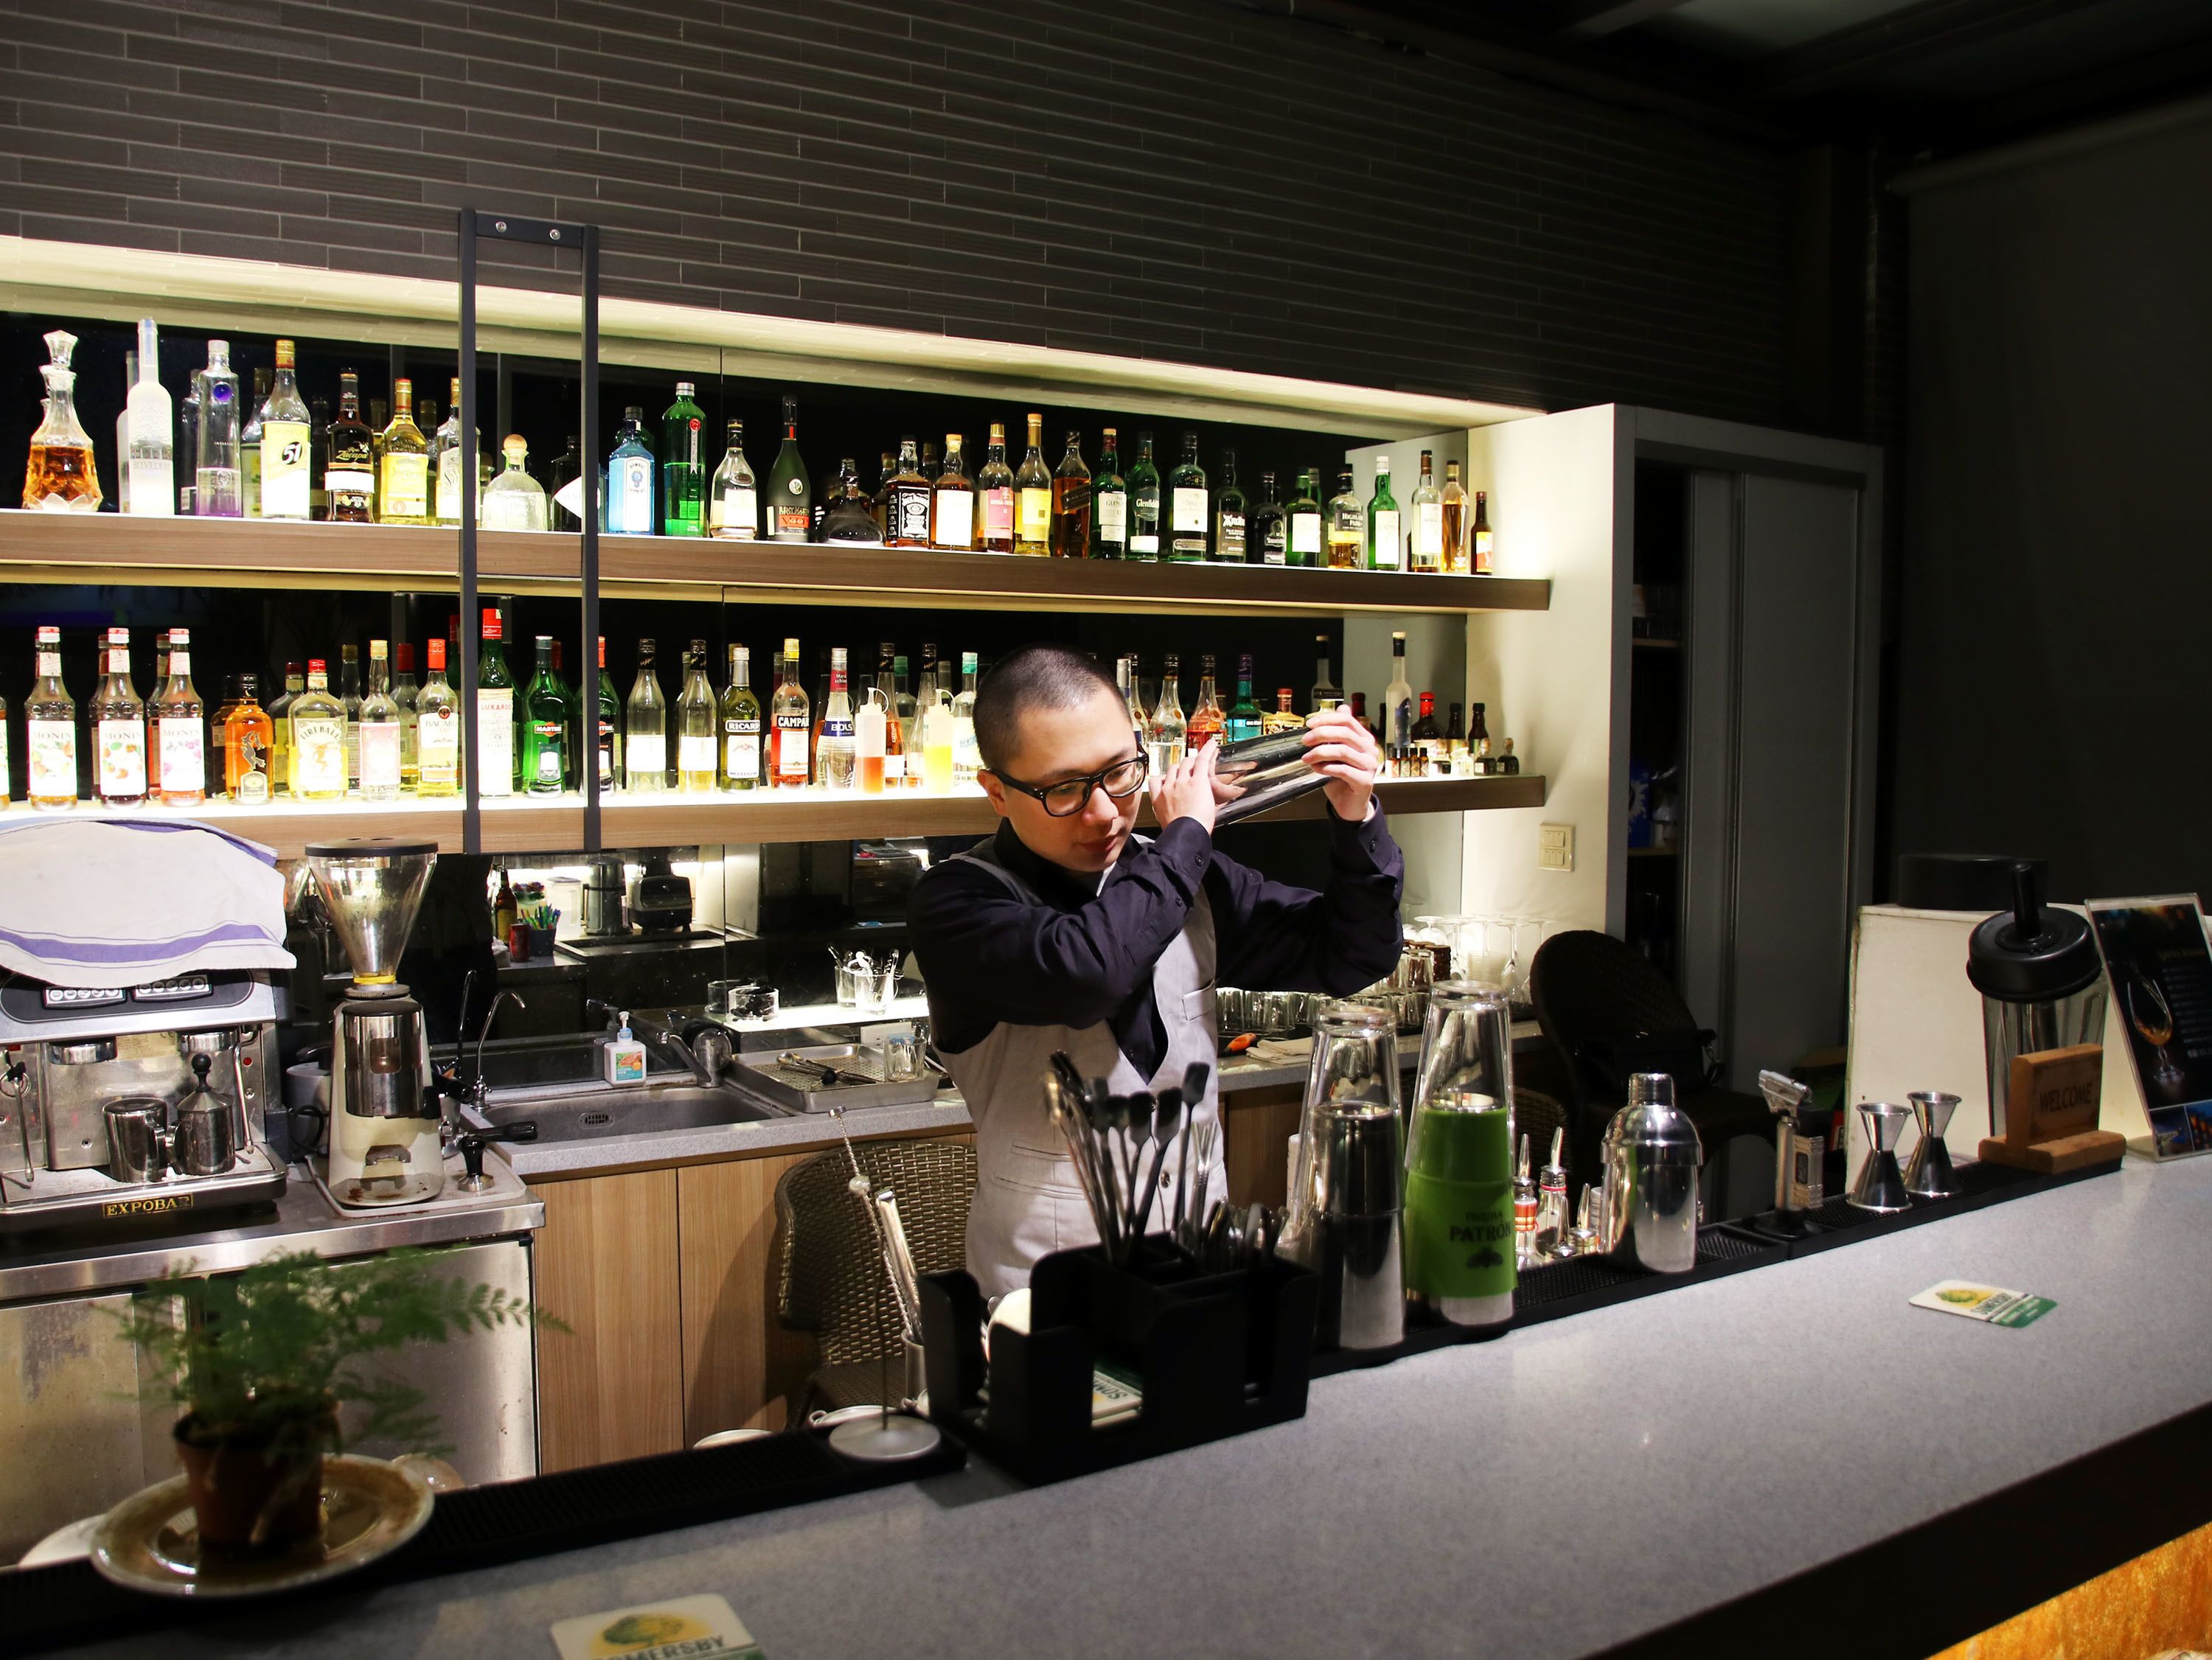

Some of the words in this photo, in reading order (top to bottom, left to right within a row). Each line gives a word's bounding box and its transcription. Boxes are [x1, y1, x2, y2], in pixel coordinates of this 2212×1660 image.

[282, 442, 303, 466] 51
[164, 729, 200, 737] MONIN
[831, 723, 852, 731] BOLS
[2039, 1082, 2093, 1115] WELCOME
